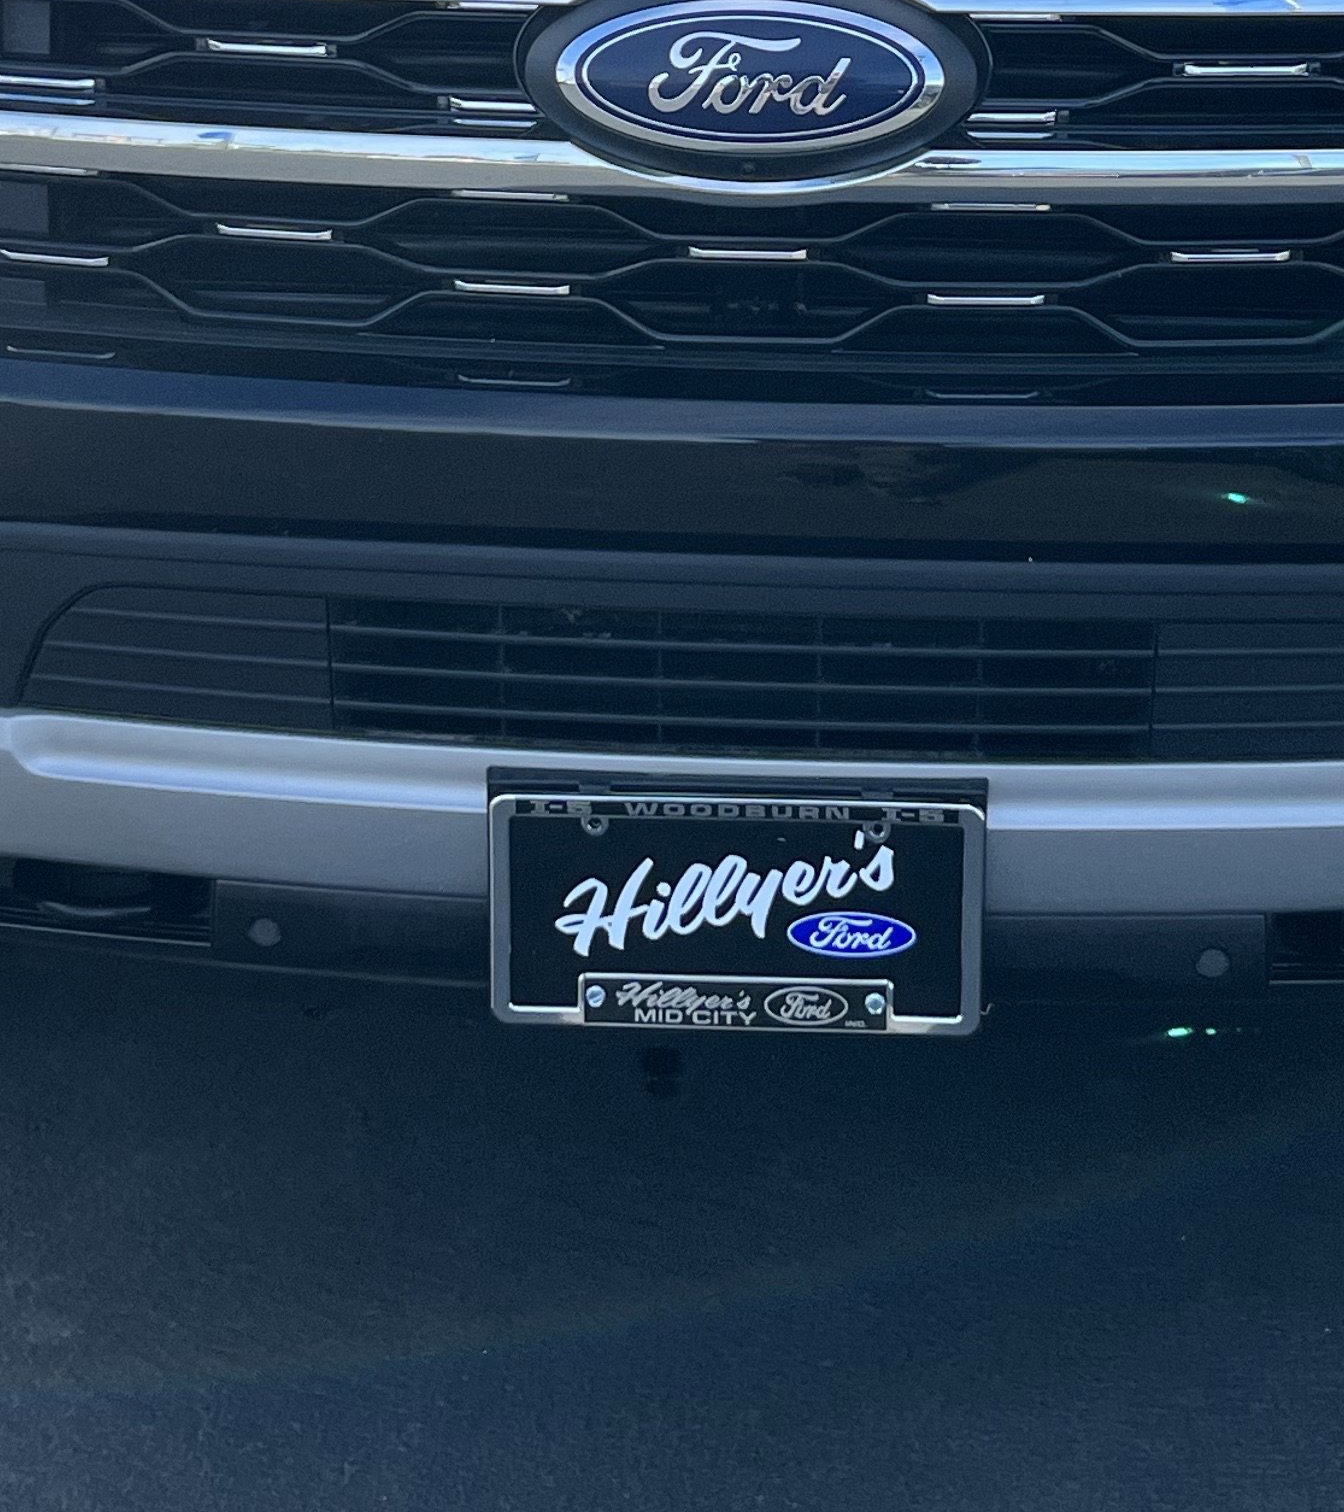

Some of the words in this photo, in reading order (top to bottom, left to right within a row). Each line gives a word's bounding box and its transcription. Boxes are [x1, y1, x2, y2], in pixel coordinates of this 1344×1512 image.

[648, 30, 852, 116] Ford
[529, 799, 593, 816] I-5
[624, 801, 850, 820] WOODBURN
[555, 830, 895, 957] Hillyer's
[809, 915, 892, 951] Ford
[615, 981, 752, 1016] Hillyer's
[779, 991, 832, 1020] Ford
[634, 1008, 684, 1024] MID
[692, 1008, 757, 1026] CITY
